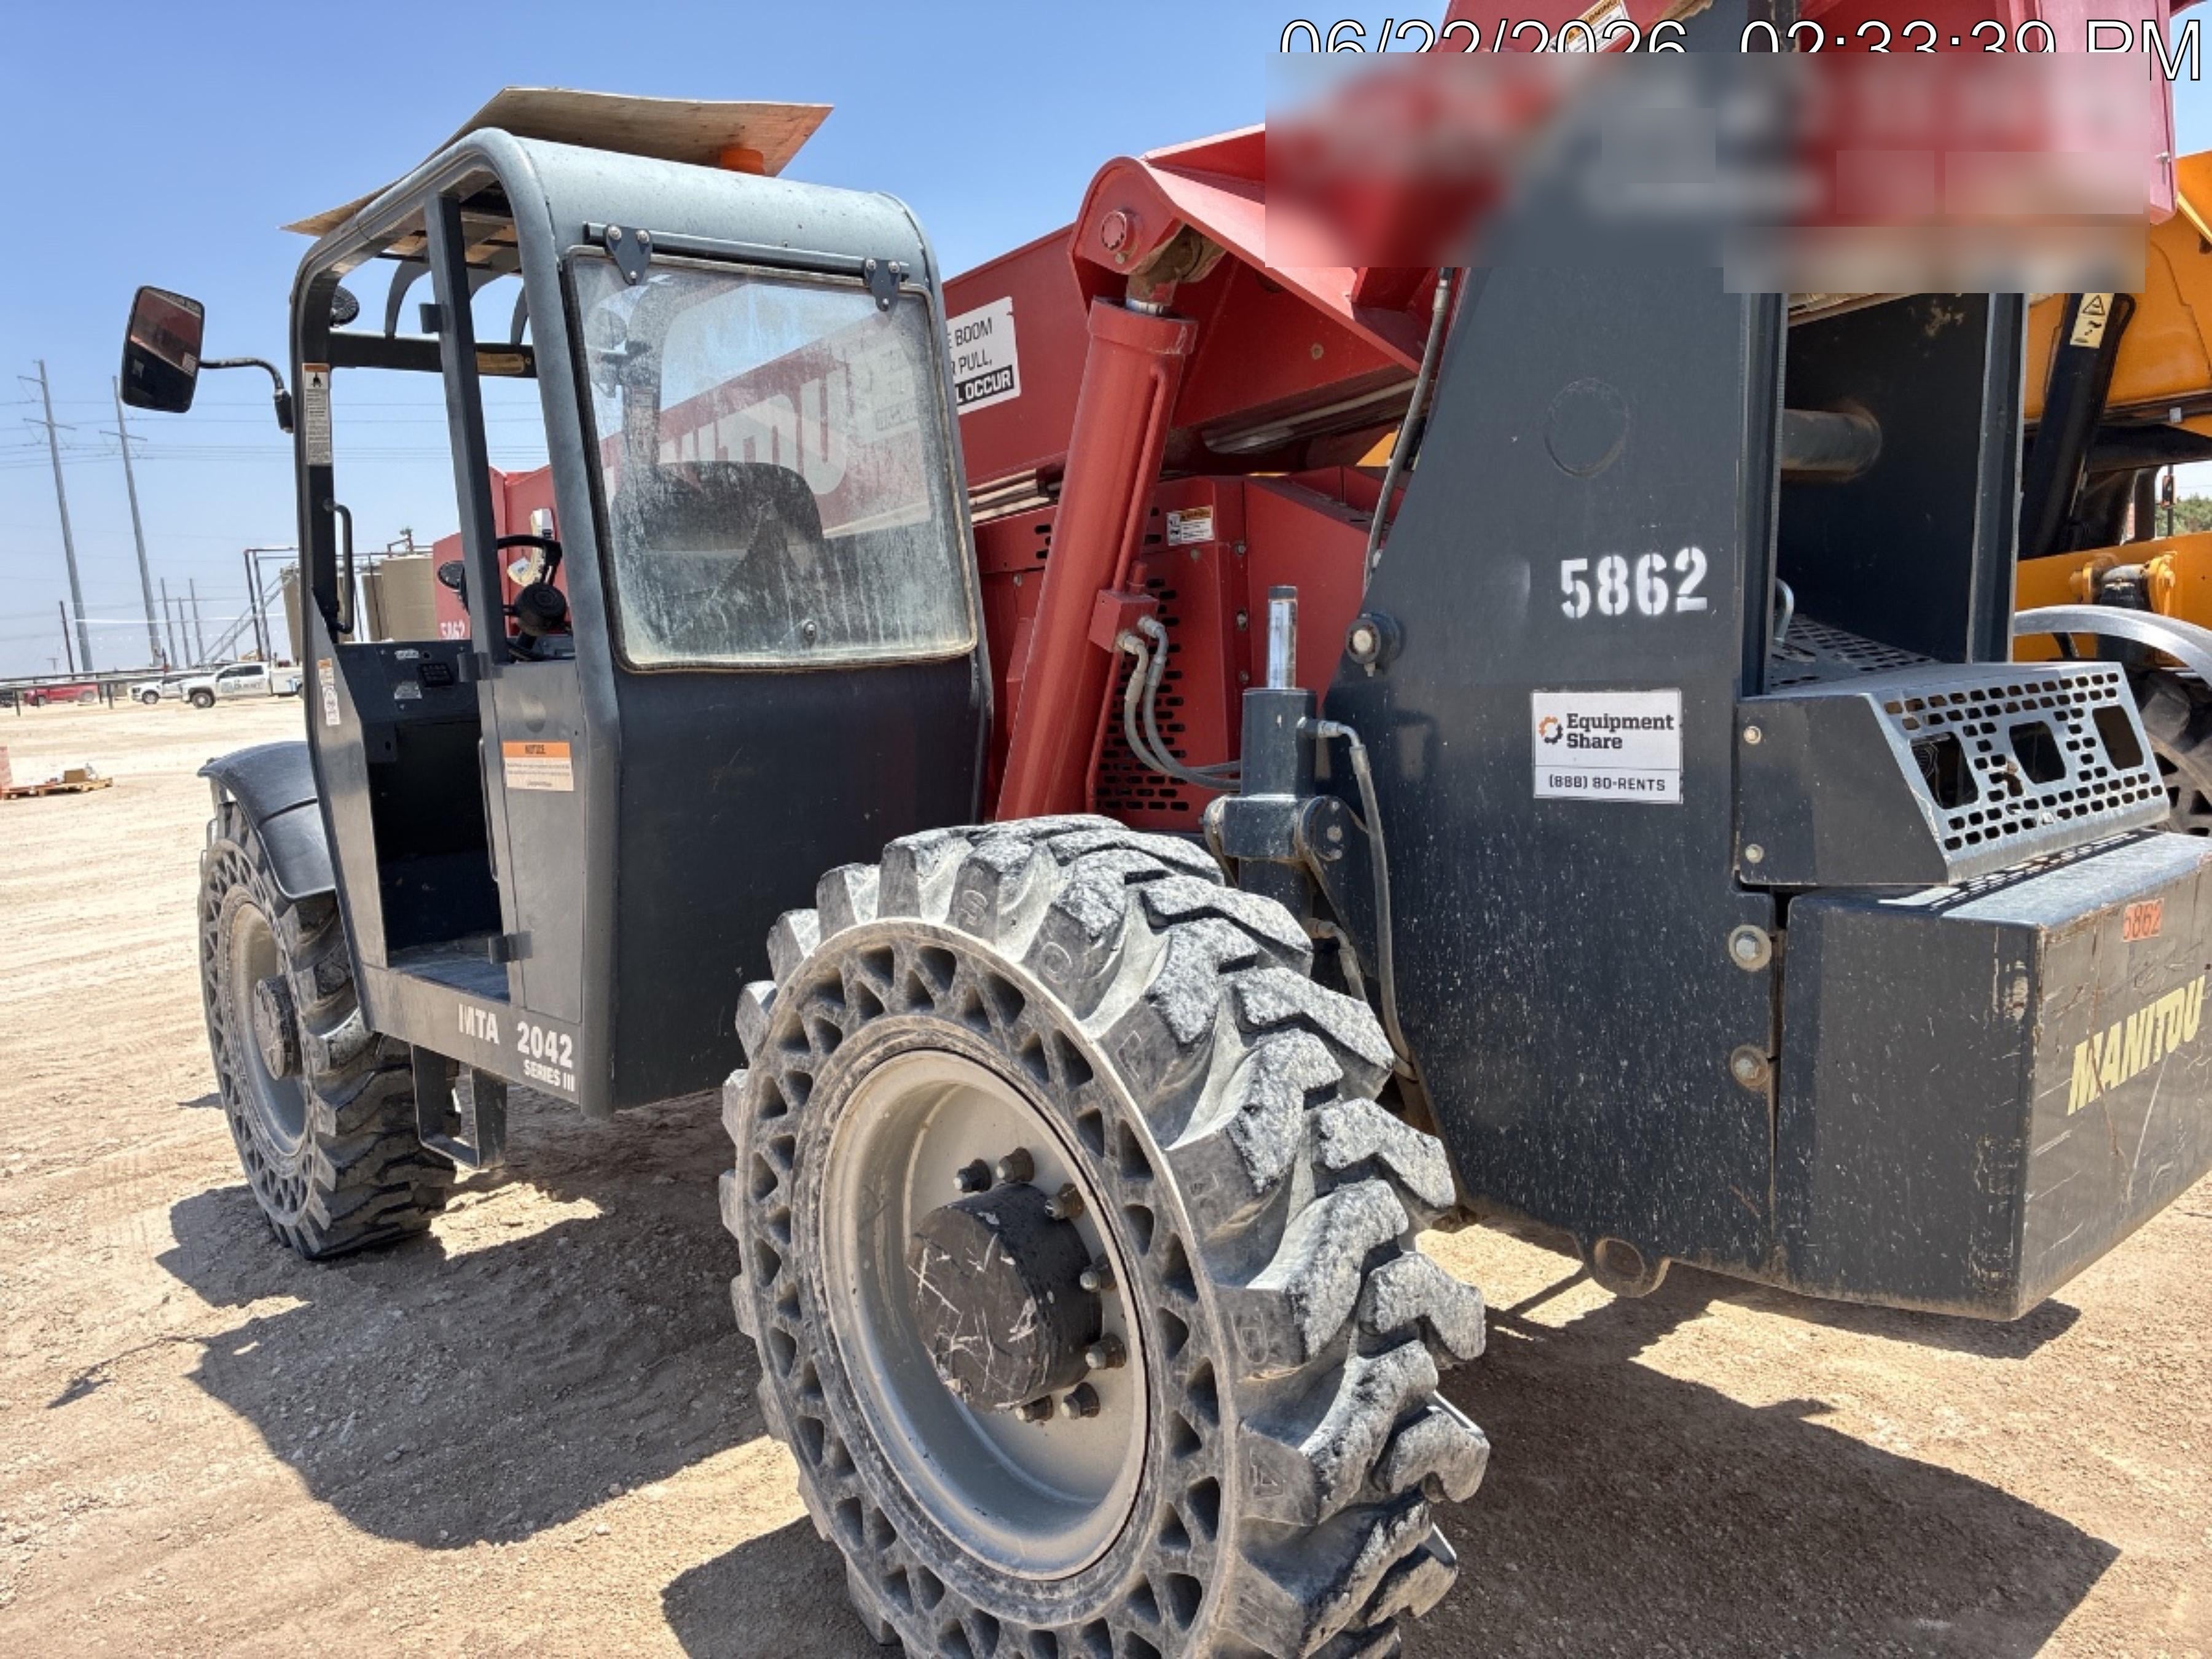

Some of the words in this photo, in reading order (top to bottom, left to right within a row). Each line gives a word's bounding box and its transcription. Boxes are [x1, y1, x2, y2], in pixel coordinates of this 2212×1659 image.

[955, 316, 992, 347] BOOM
[965, 369, 1011, 401] OCCUR
[1560, 546, 1708, 619] 5862
[1567, 713, 1674, 732] Equipment
[1567, 732, 1623, 749] Share
[1549, 774, 1588, 789] (888)
[1592, 777, 1665, 791] 80-RENTS
[458, 1003, 500, 1045] MTA
[517, 1021, 573, 1069] 2042
[2067, 974, 2206, 1116] MANITOU
[524, 1059, 560, 1087] SERIES
[563, 1072, 575, 1092] III
